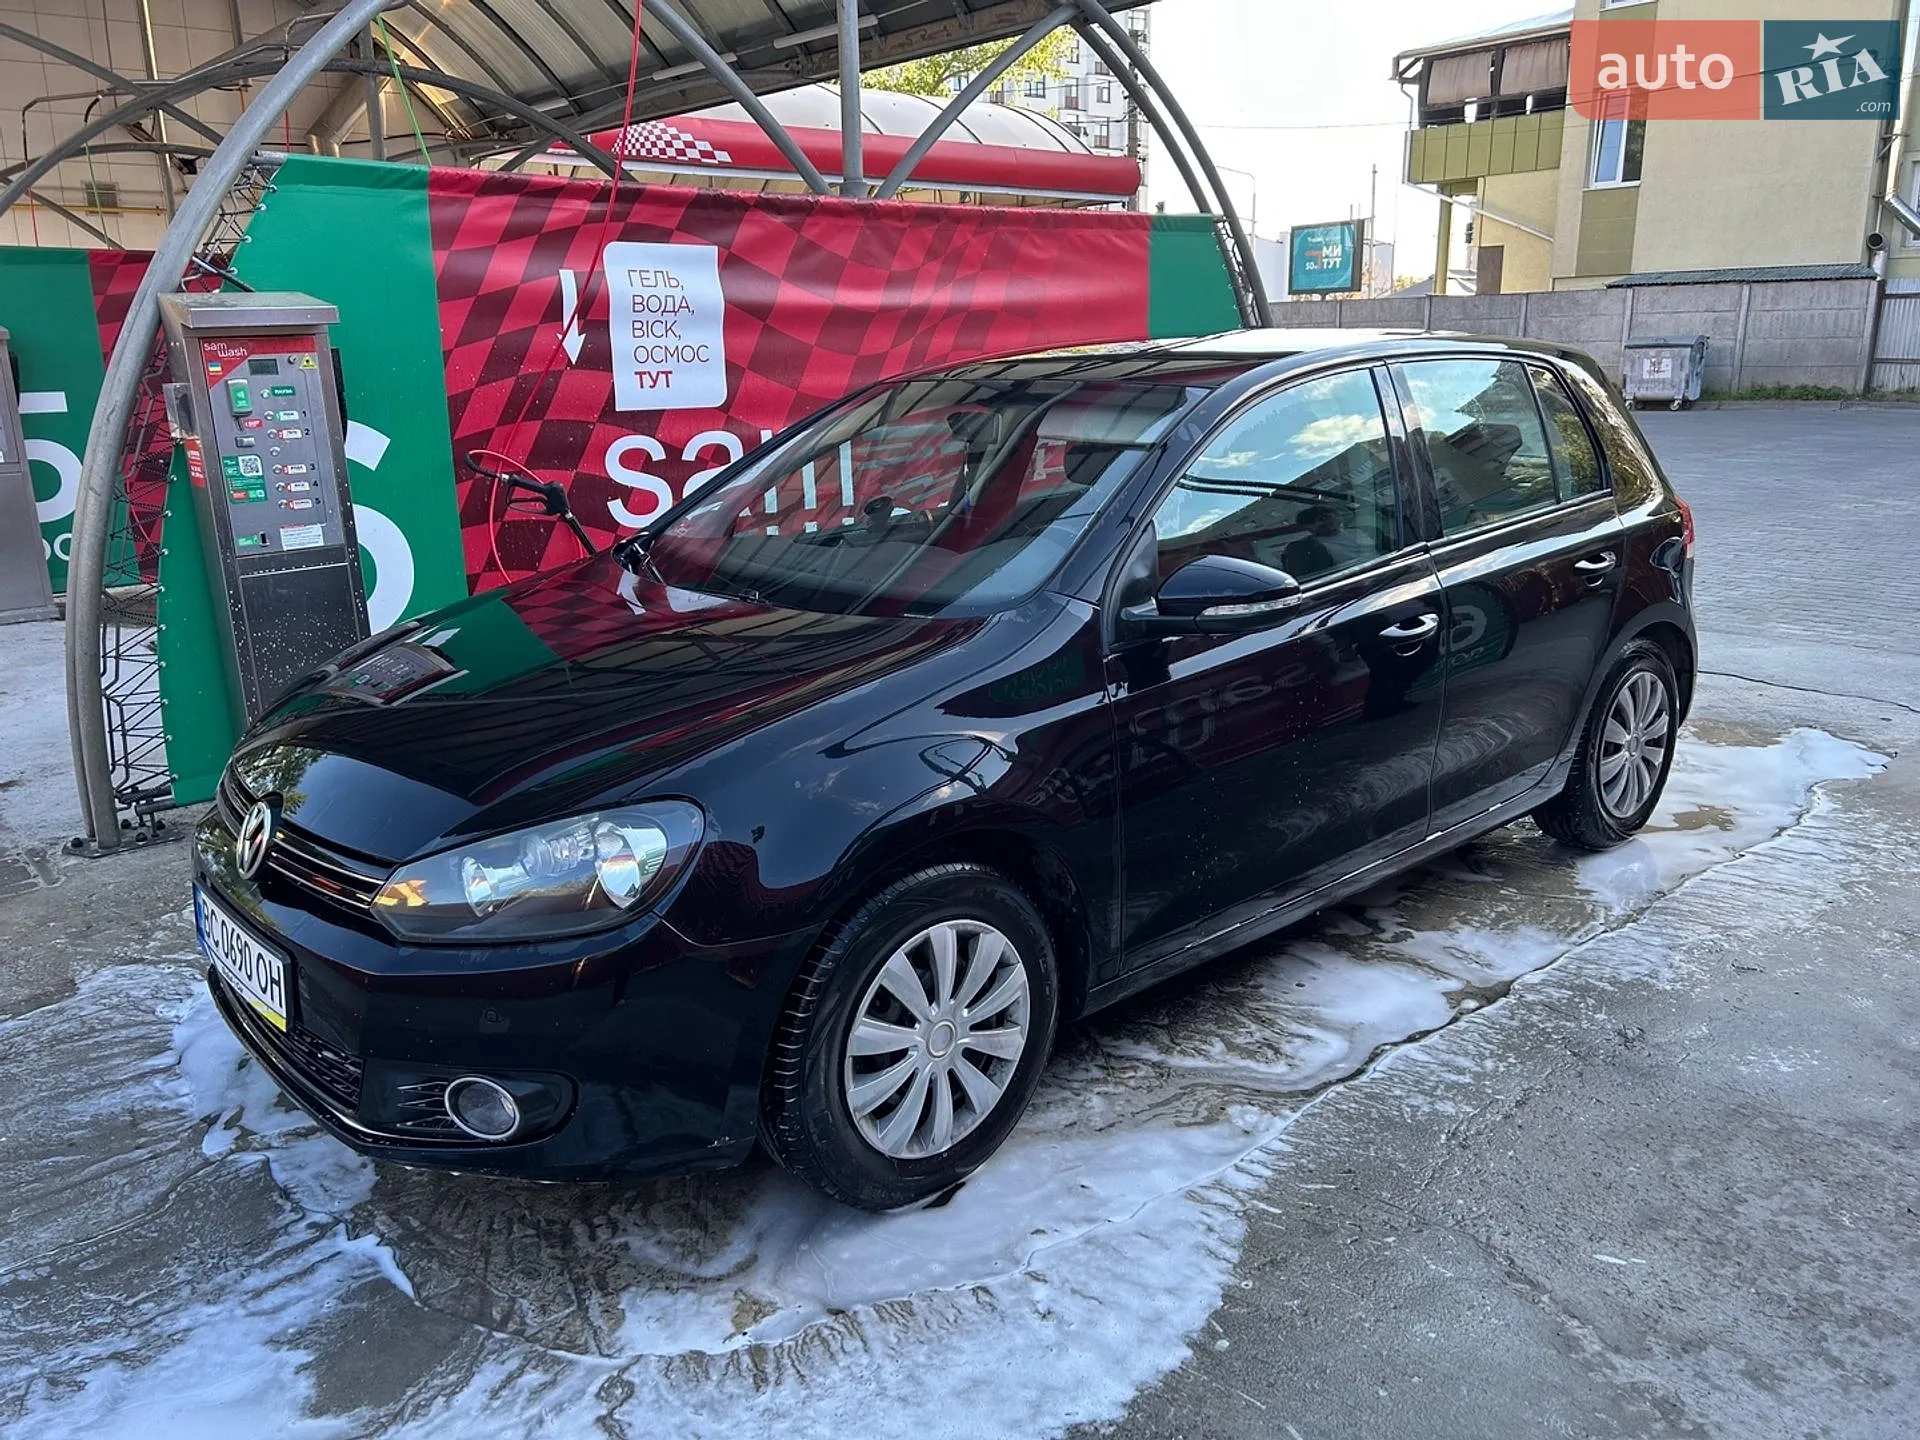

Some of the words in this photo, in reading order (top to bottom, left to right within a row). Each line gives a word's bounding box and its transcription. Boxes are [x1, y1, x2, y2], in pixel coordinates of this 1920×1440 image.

[1323, 245, 1342, 257] МИ
[1323, 258, 1342, 269] ТУТ
[628, 269, 684, 291] ГЕЛЬ,
[632, 295, 695, 316] ВОДА,
[632, 320, 681, 341] ВІСК,
[204, 341, 228, 351] sam
[218, 346, 248, 358] wash
[633, 345, 710, 364] ОСМОС
[634, 371, 673, 389] ТУТ
[304, 428, 310, 436] 2
[202, 898, 219, 948] BC
[221, 919, 252, 982] 0690
[257, 952, 283, 1009] OH
